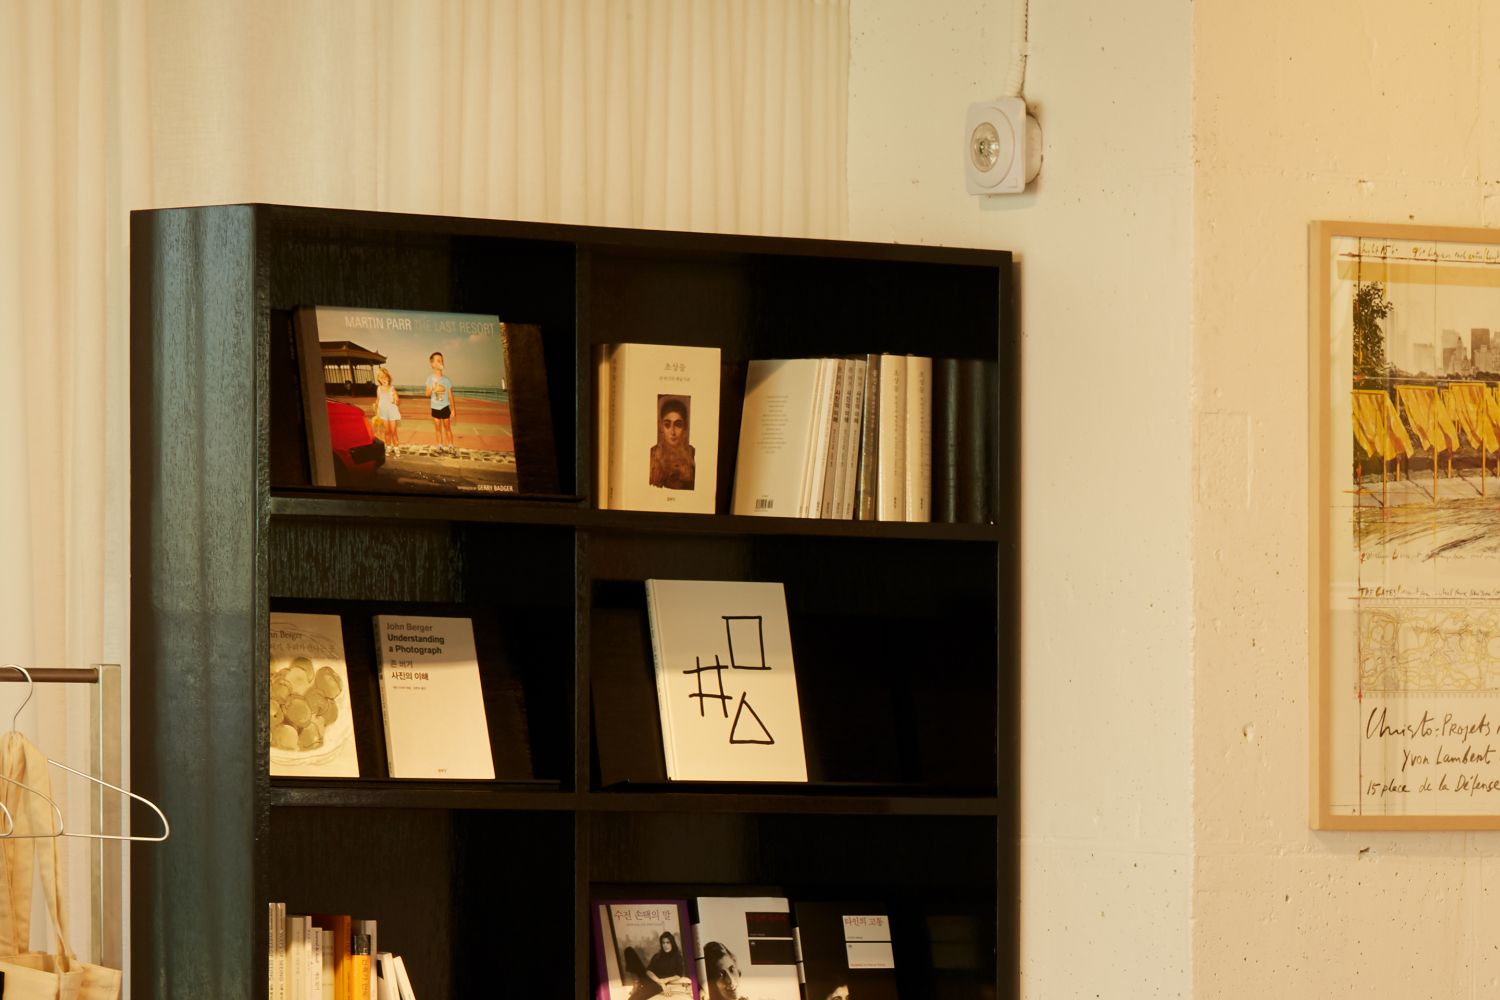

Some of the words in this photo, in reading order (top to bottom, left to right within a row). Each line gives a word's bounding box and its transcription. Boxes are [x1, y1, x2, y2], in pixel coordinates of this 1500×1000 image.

[344, 316, 383, 329] MARTIN
[386, 318, 412, 330] PARR
[459, 321, 494, 336] RESORT
[386, 622, 404, 632] John
[406, 623, 432, 634] Berger
[388, 633, 444, 646] Understanding
[395, 645, 442, 655] Photograph
[1442, 713, 1490, 744] Projets
[1402, 748, 1430, 772] Yvon
[1436, 744, 1496, 765] Lambert
[1381, 778, 1411, 797] place
[1419, 776, 1433, 793] de
[1438, 774, 1450, 792] la
